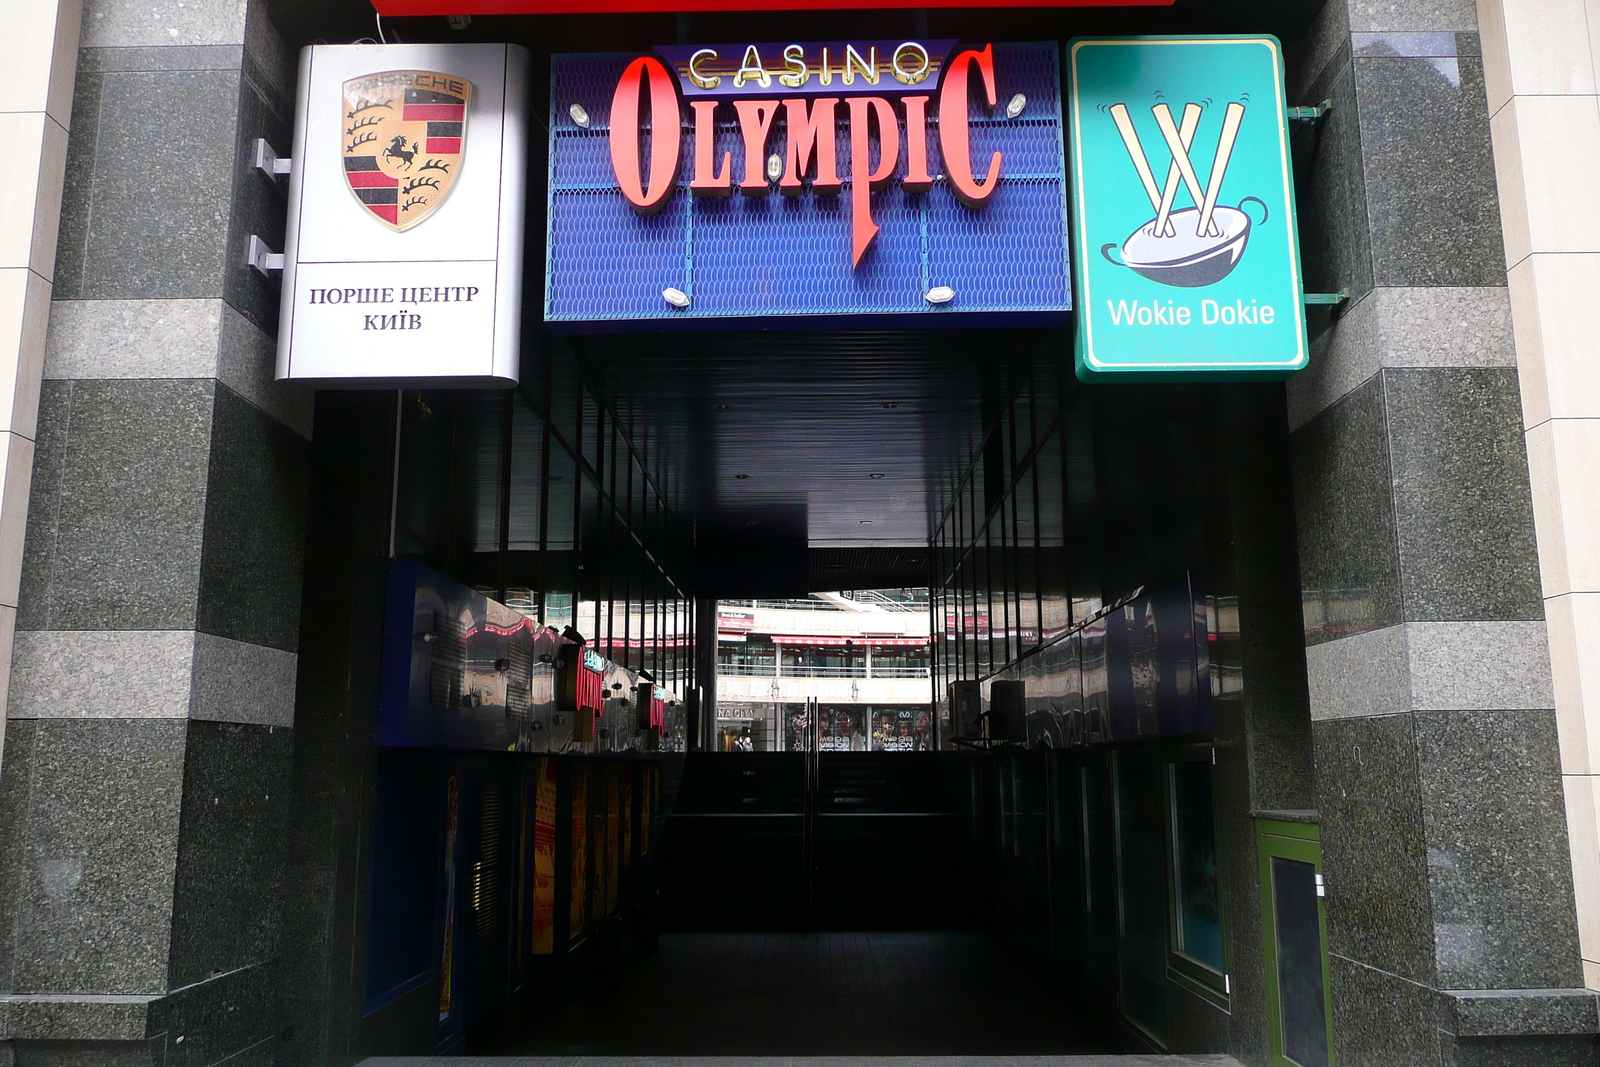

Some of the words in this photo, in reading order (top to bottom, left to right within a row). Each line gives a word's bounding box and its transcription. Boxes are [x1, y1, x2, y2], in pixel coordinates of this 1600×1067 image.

[689, 41, 930, 88] CASINO
[609, 42, 1002, 270] OLYMPIC
[309, 288, 394, 305] ПОРШЕ
[400, 286, 479, 306] ЦЕНТР
[363, 310, 422, 331] КИЇВ
[1106, 299, 1191, 326] Wokie
[1201, 298, 1275, 325] Dokie
[733, 709, 755, 718] CITY
